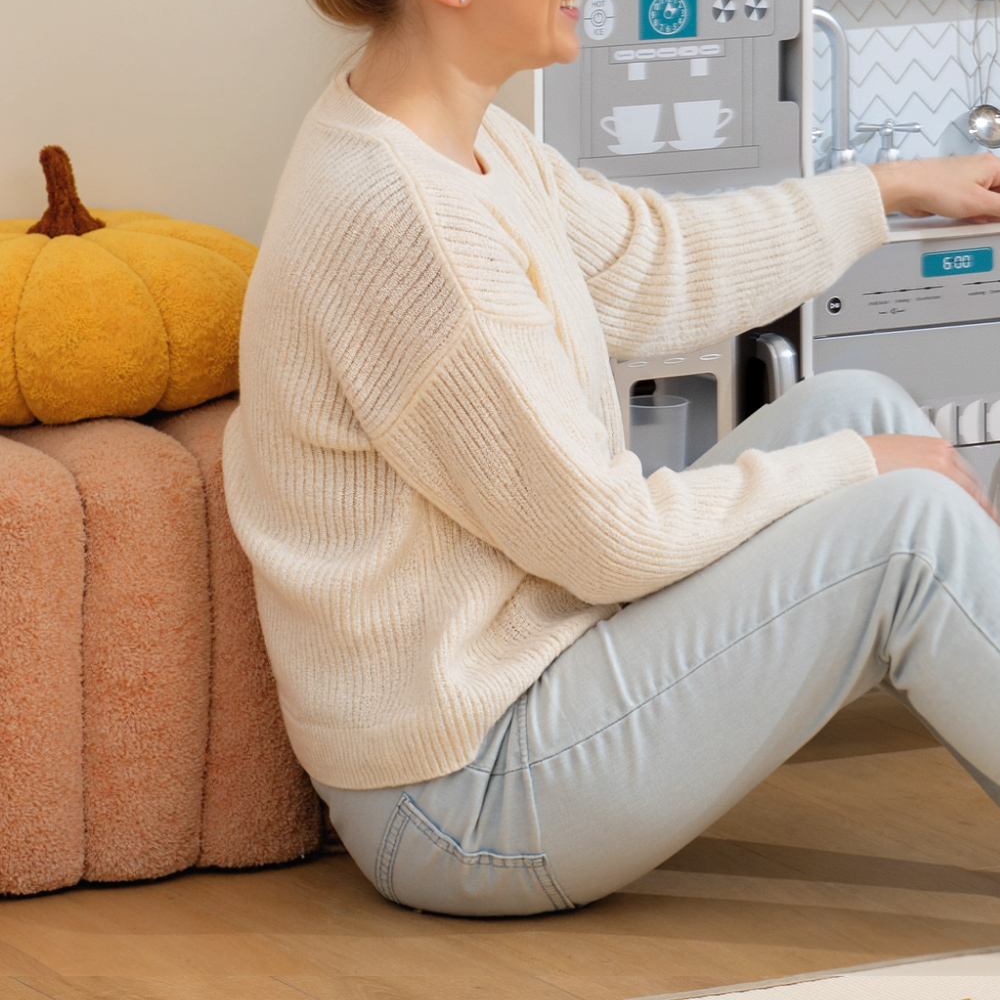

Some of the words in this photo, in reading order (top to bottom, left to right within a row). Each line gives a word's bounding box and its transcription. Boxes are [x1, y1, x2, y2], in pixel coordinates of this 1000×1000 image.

[591, 0, 606, 8] HOT
[593, 28, 604, 36] ICE
[942, 255, 971, 270] 6:00
